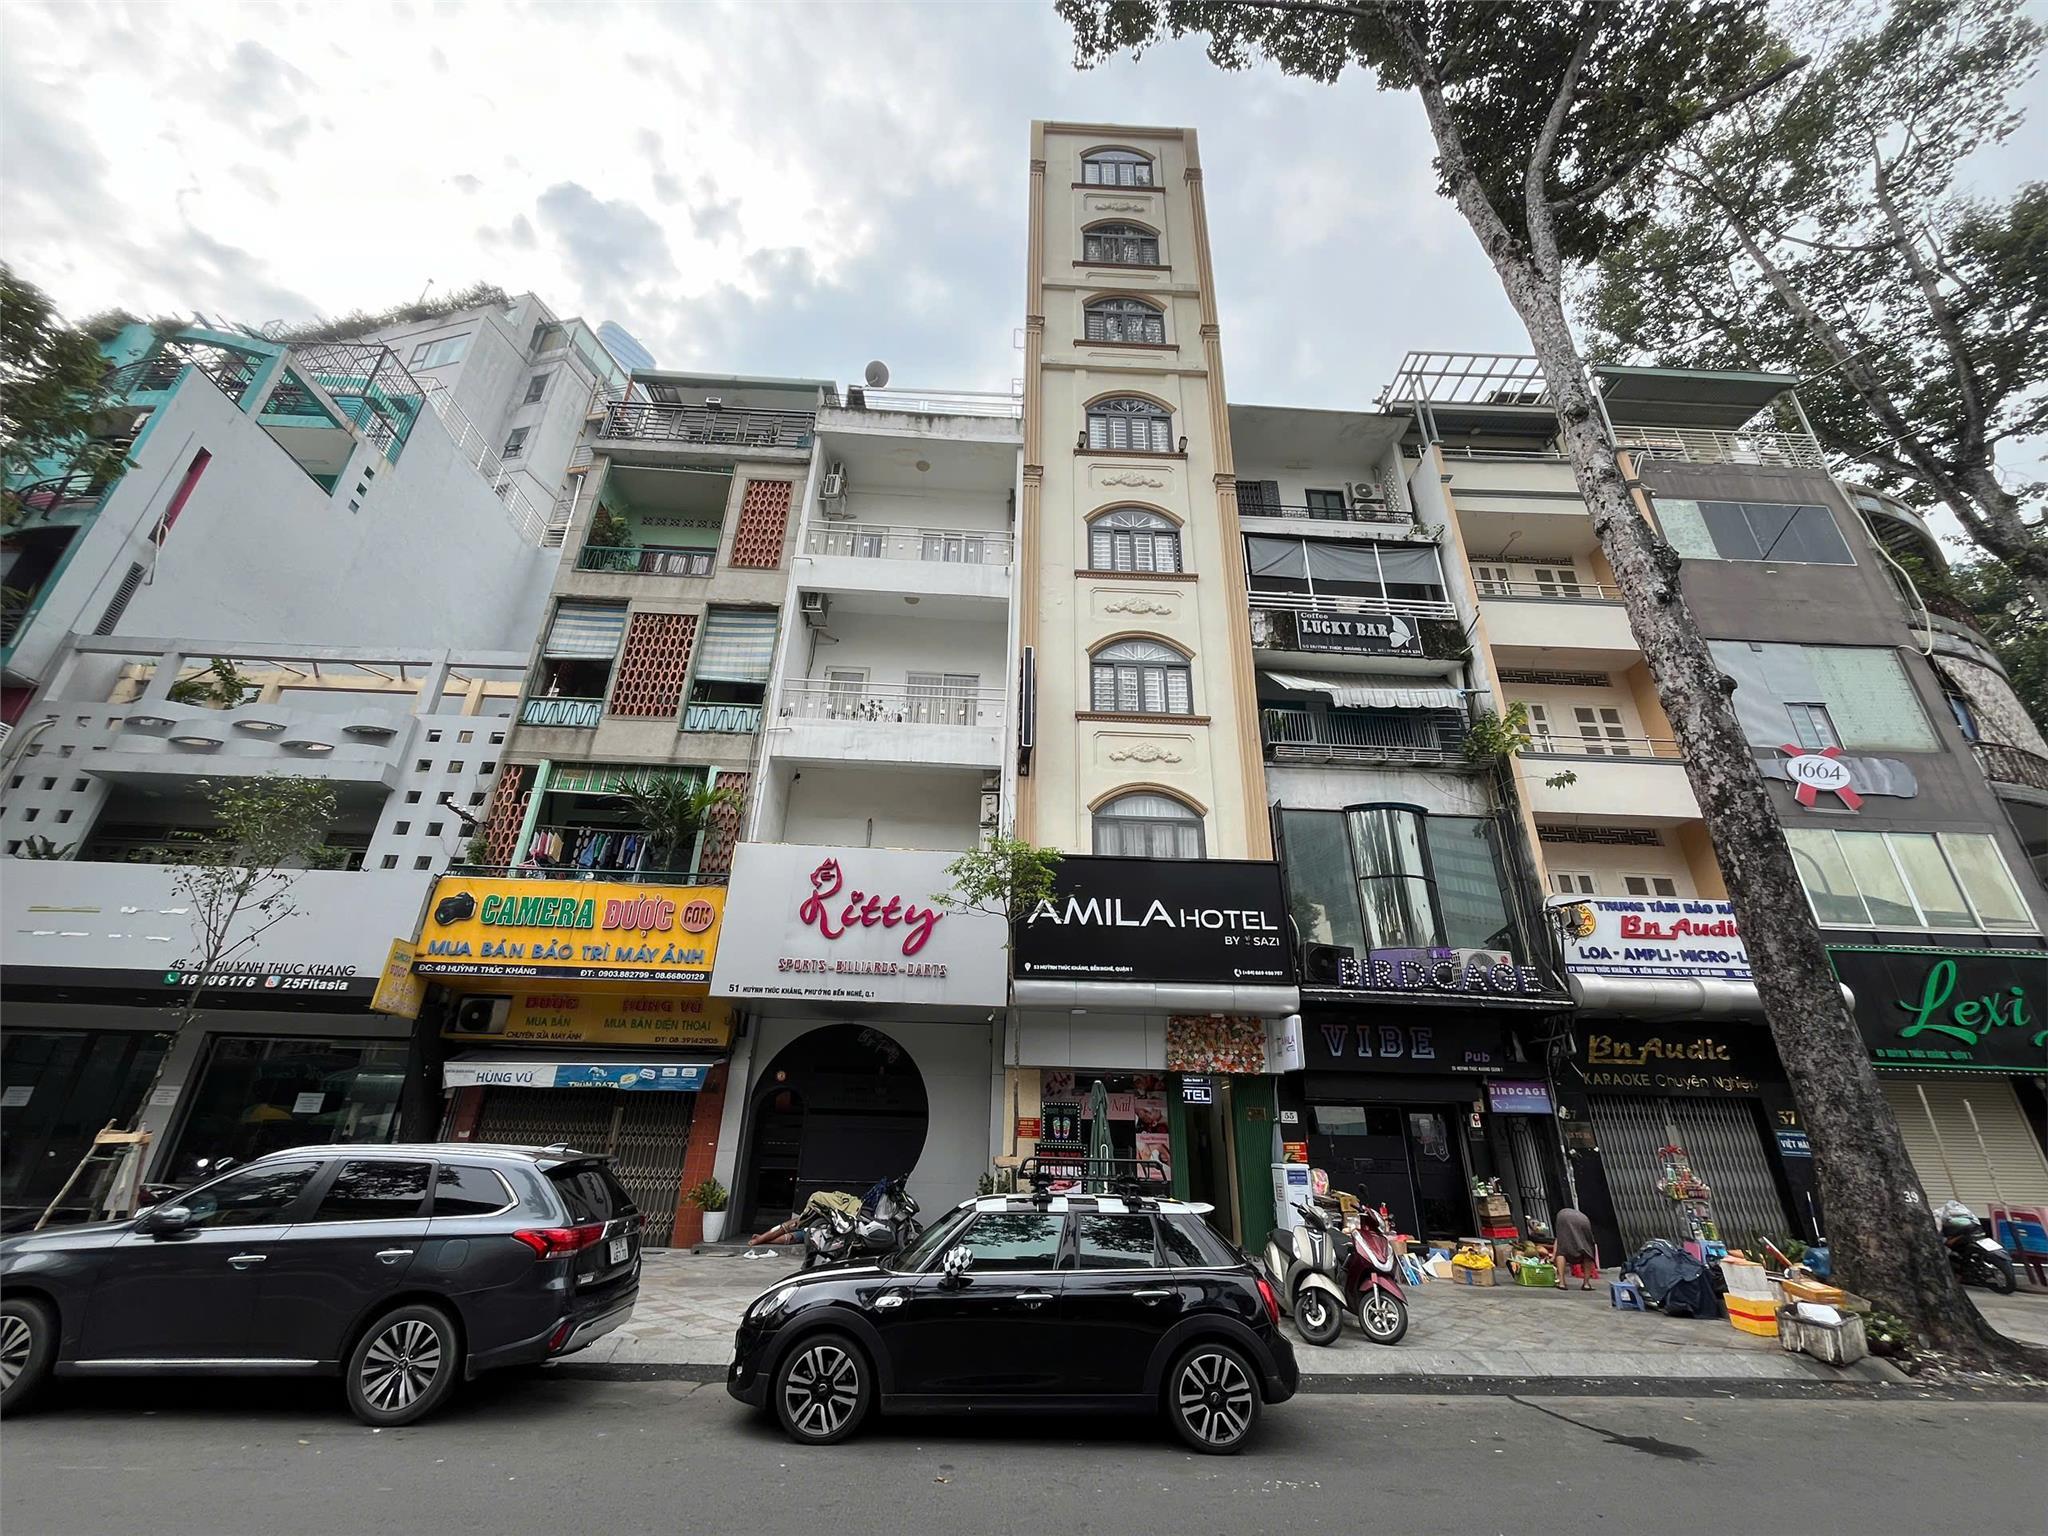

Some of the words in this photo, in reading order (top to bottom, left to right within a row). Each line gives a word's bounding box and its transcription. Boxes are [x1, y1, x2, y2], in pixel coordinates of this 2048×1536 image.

[1302, 619, 1352, 635] LUCKY
[1355, 622, 1390, 638] BAR
[1798, 761, 1844, 781] 1664
[480, 894, 596, 929] CAMERA
[602, 892, 675, 938] ĐƯỢC
[800, 857, 943, 956] Kitty
[1027, 897, 1176, 928] AMILA
[1180, 909, 1278, 930] HOTEL
[1594, 901, 1646, 912] TRUNG
[1647, 900, 1680, 913] TÂM
[1668, 917, 1739, 940] Audi
[1224, 936, 1240, 946] BY
[1253, 936, 1280, 946] SAZI
[428, 940, 472, 957] MUA
[480, 938, 525, 958] BÁN
[531, 939, 574, 960] BẢO
[615, 944, 660, 963] MÁY
[661, 943, 706, 964] ẢNH
[1579, 946, 1612, 960] LOA
[1624, 947, 1672, 962] AMPLI
[1681, 949, 1729, 964] MICRO
[169, 959, 185, 970] 45
[307, 963, 357, 979] KHANG
[419, 964, 434, 972] ĐC:
[435, 964, 446, 972] 49
[448, 964, 478, 973] HUỲNH
[480, 965, 504, 974] THÚC
[505, 966, 537, 975] KHÁNG
[580, 969, 595, 978] ĐT:
[778, 958, 826, 974] SPORTS
[836, 960, 898, 977] BILLIARDS
[907, 962, 949, 979] DARTS
[1338, 957, 1544, 993] BIRDCAGE
[729, 984, 740, 993] 51
[1899, 959, 2032, 1046] Lexi
[525, 1016, 548, 1027] MUA
[604, 1018, 627, 1029] MUA
[1320, 1024, 1437, 1060] VIBE
[1464, 1050, 1490, 1063] Pub
[476, 1067, 513, 1083] HÙNG
[1583, 1074, 1651, 1087] KARAOKE
[1655, 1074, 1709, 1090] Chuyên
[1489, 1086, 1548, 1096] BIRDCAGE
[1110, 1095, 1132, 1113] Nail
[1284, 1112, 1295, 1121] 55
[1776, 1110, 1796, 1125] 57
[1903, 1190, 1919, 1203] 39
